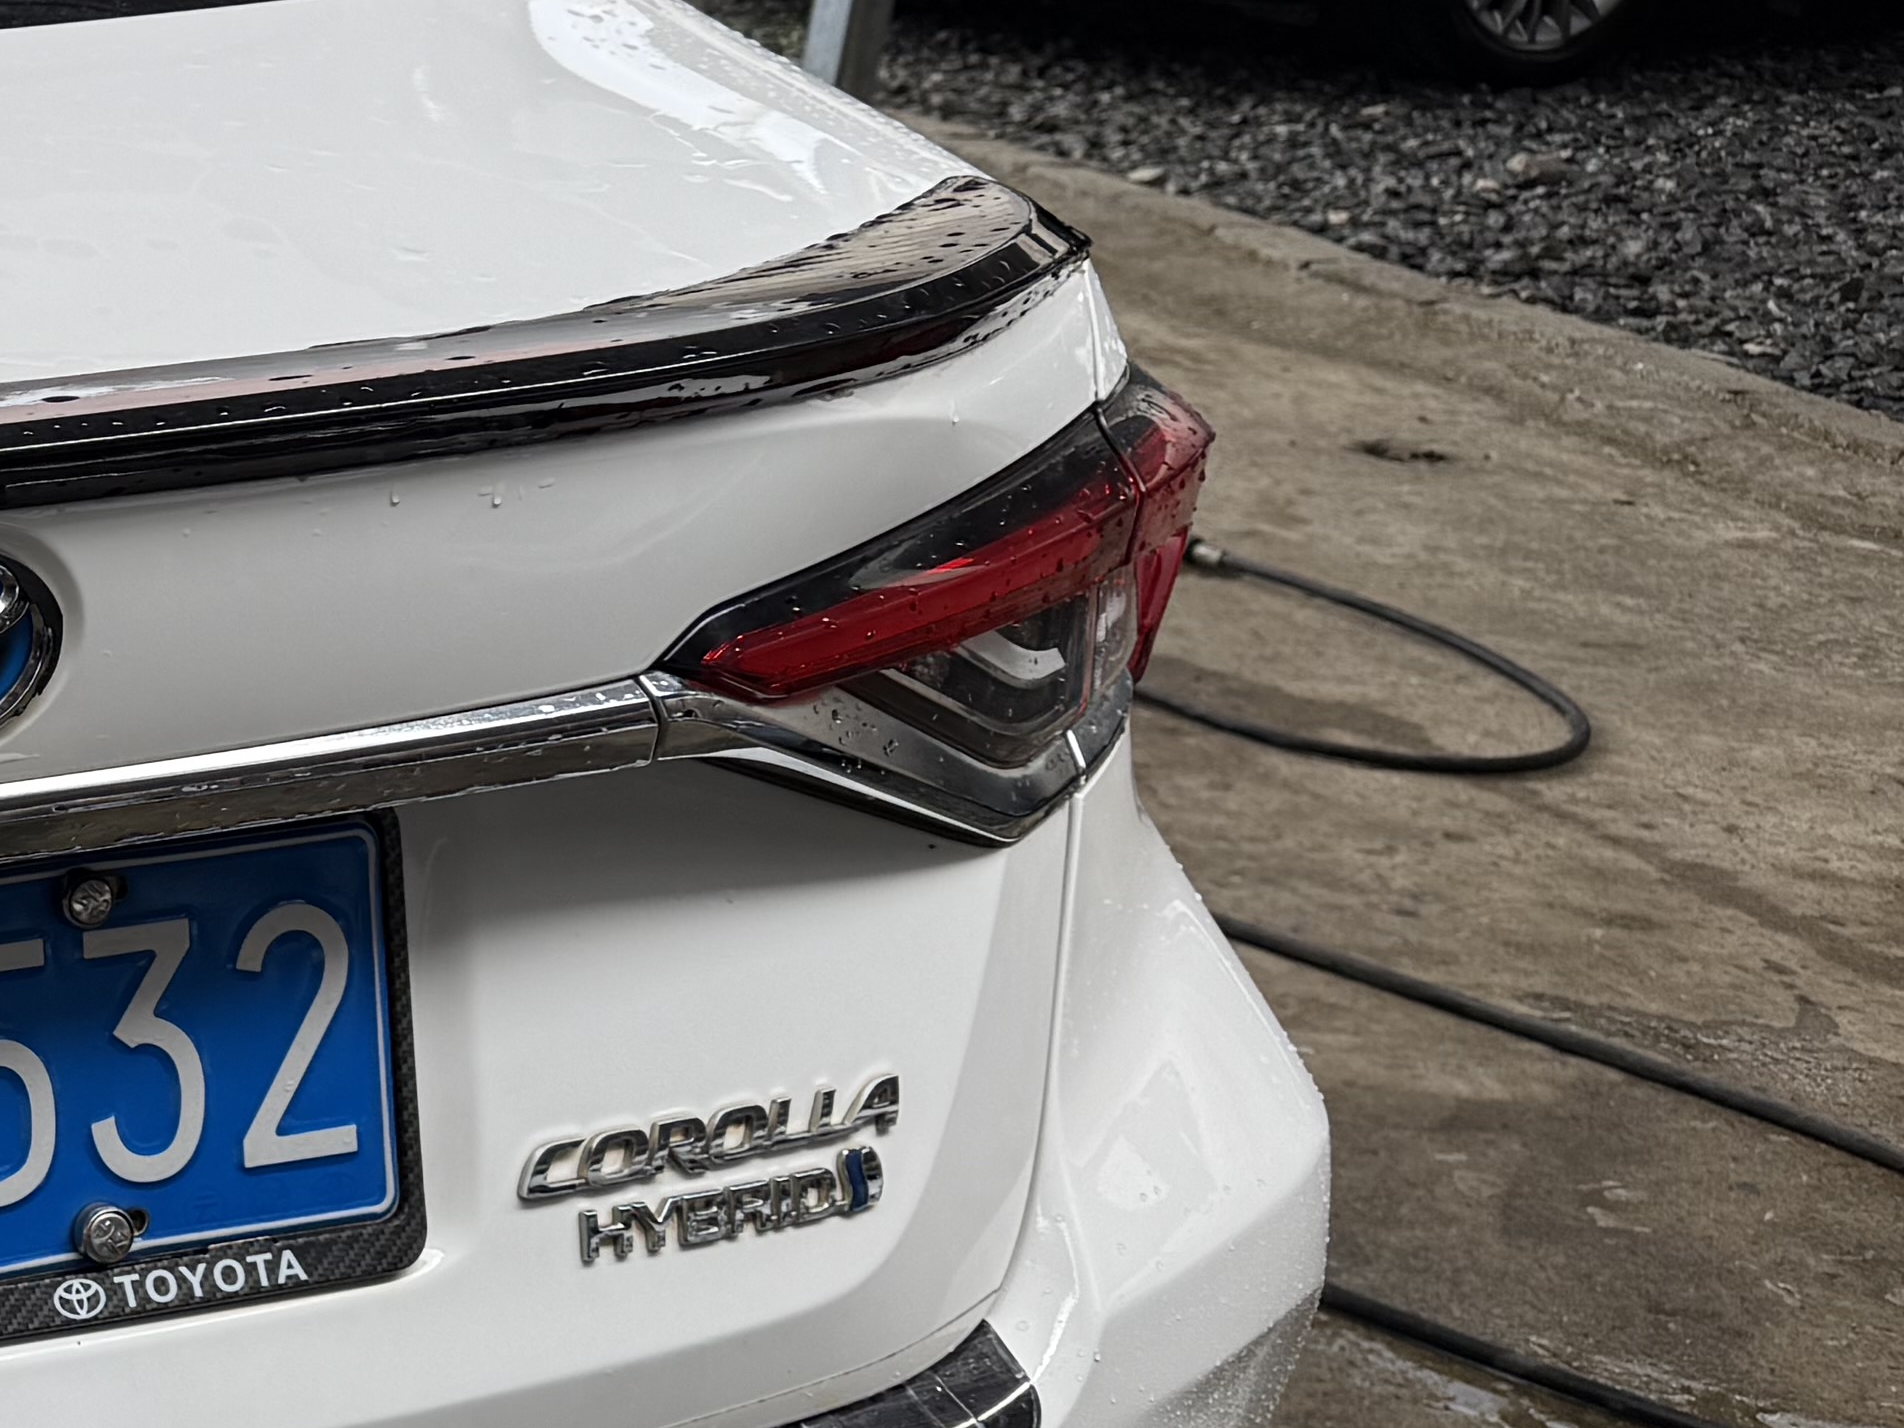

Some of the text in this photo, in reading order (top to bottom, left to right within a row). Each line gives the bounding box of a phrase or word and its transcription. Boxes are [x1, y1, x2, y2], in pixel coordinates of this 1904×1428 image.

[517, 1073, 900, 1203] COROLLA
[578, 1166, 842, 1264] HYBRID
[113, 1249, 309, 1308] TOYOTA
